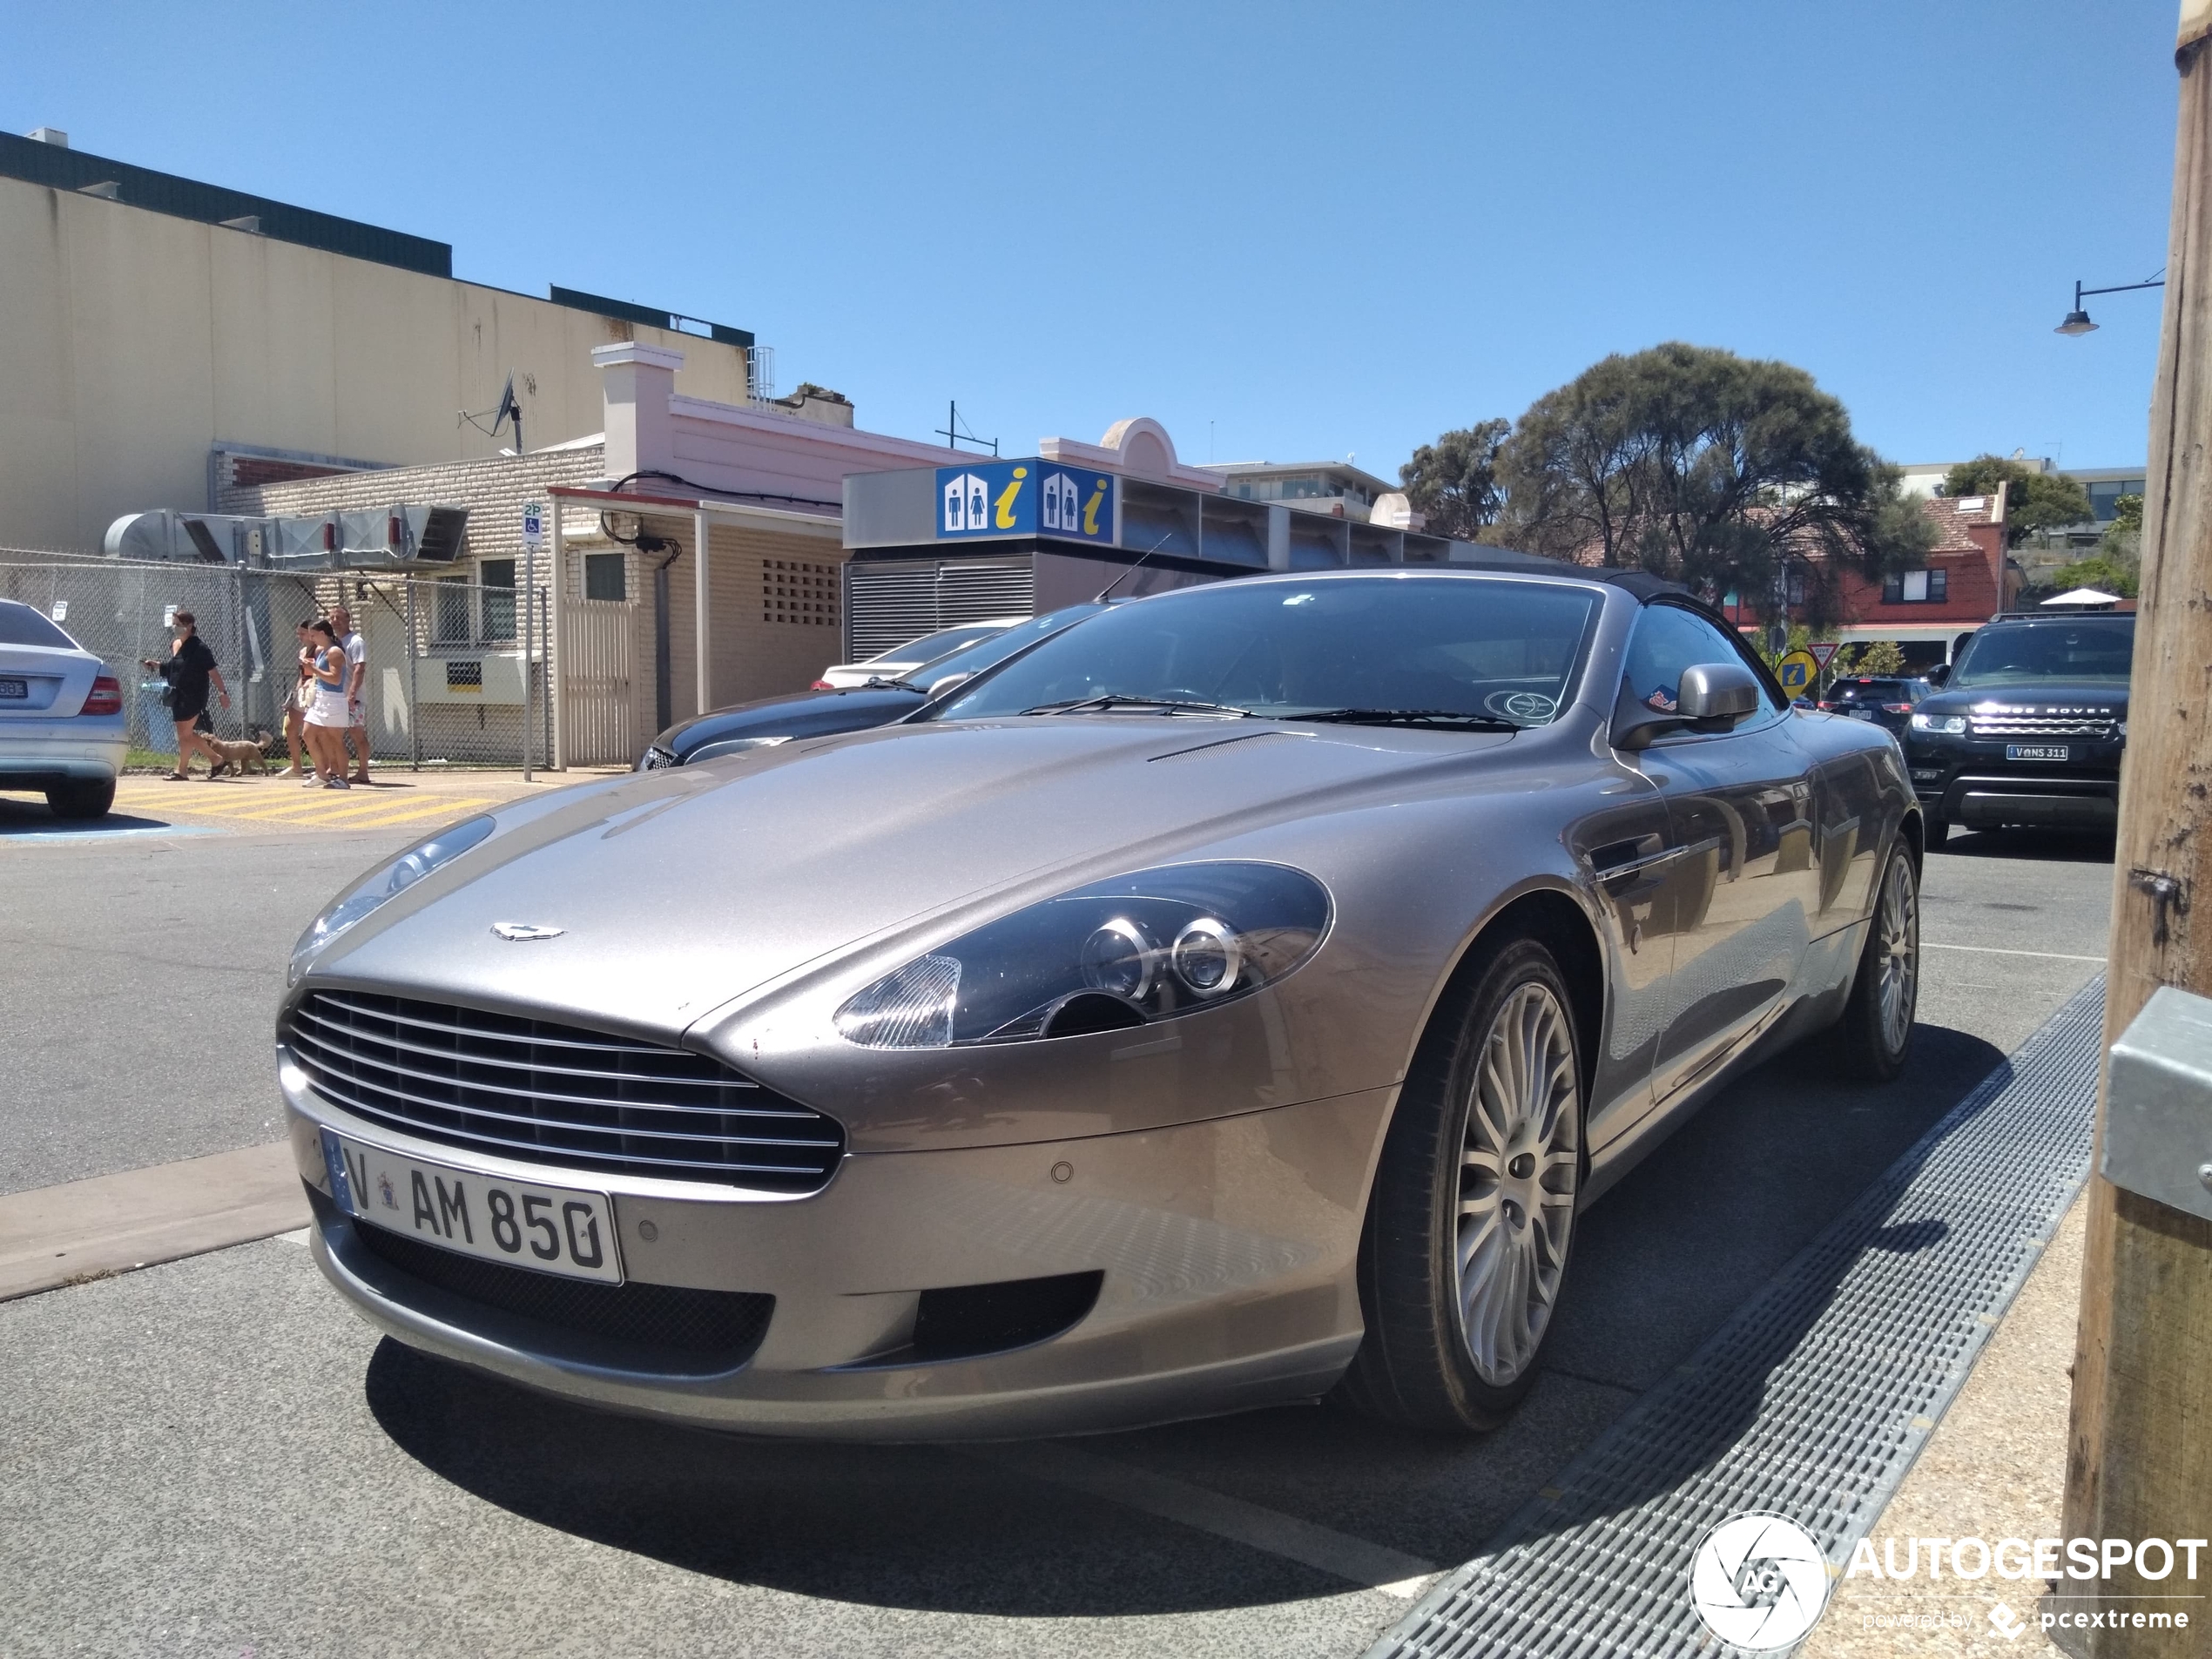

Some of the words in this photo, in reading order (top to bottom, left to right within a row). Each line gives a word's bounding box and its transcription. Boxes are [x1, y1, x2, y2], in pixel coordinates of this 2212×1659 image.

[524, 504, 541, 516] 2P
[2047, 748, 2066, 758] 311
[343, 1147, 368, 1210] V
[411, 1170, 474, 1244] AM
[488, 1189, 604, 1269] 850
